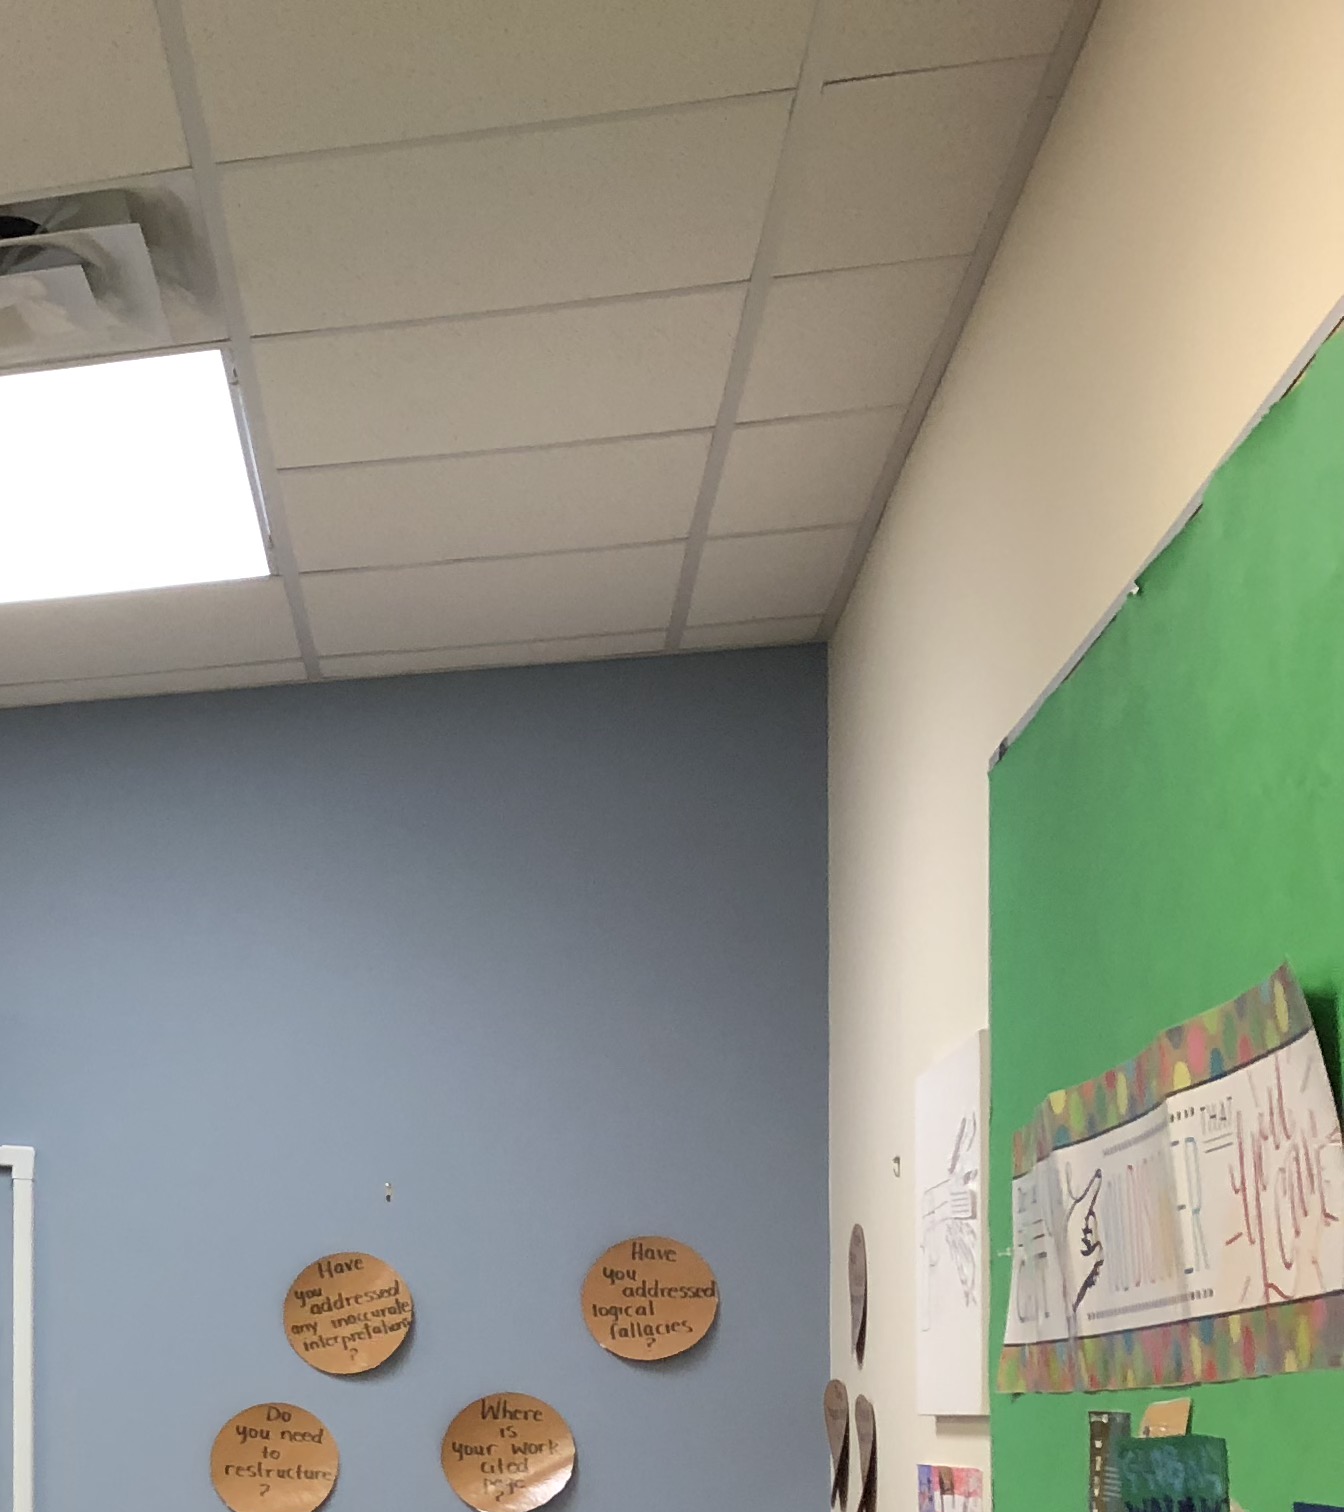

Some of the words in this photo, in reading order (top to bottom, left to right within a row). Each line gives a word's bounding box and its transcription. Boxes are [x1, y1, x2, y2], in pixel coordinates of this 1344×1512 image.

[632, 1241, 677, 1262] Have
[317, 1258, 365, 1279] Have
[602, 1266, 637, 1286] you
[294, 1287, 323, 1308] you
[310, 1279, 400, 1315] addressed
[621, 1279, 716, 1299] addressed
[291, 1321, 318, 1336] any
[331, 1298, 412, 1329] inaccurate
[592, 1300, 655, 1322] logical
[610, 1320, 694, 1341] fallacies
[266, 1405, 292, 1422] Do
[480, 1397, 543, 1421] Where
[235, 1424, 270, 1445] you
[280, 1428, 324, 1444] need
[499, 1425, 518, 1438] is
[262, 1445, 280, 1460] to
[452, 1441, 498, 1461] your
[512, 1439, 559, 1455] work
[224, 1461, 332, 1481] restructure
[480, 1458, 529, 1474] cited
[259, 1483, 270, 1497] ?
